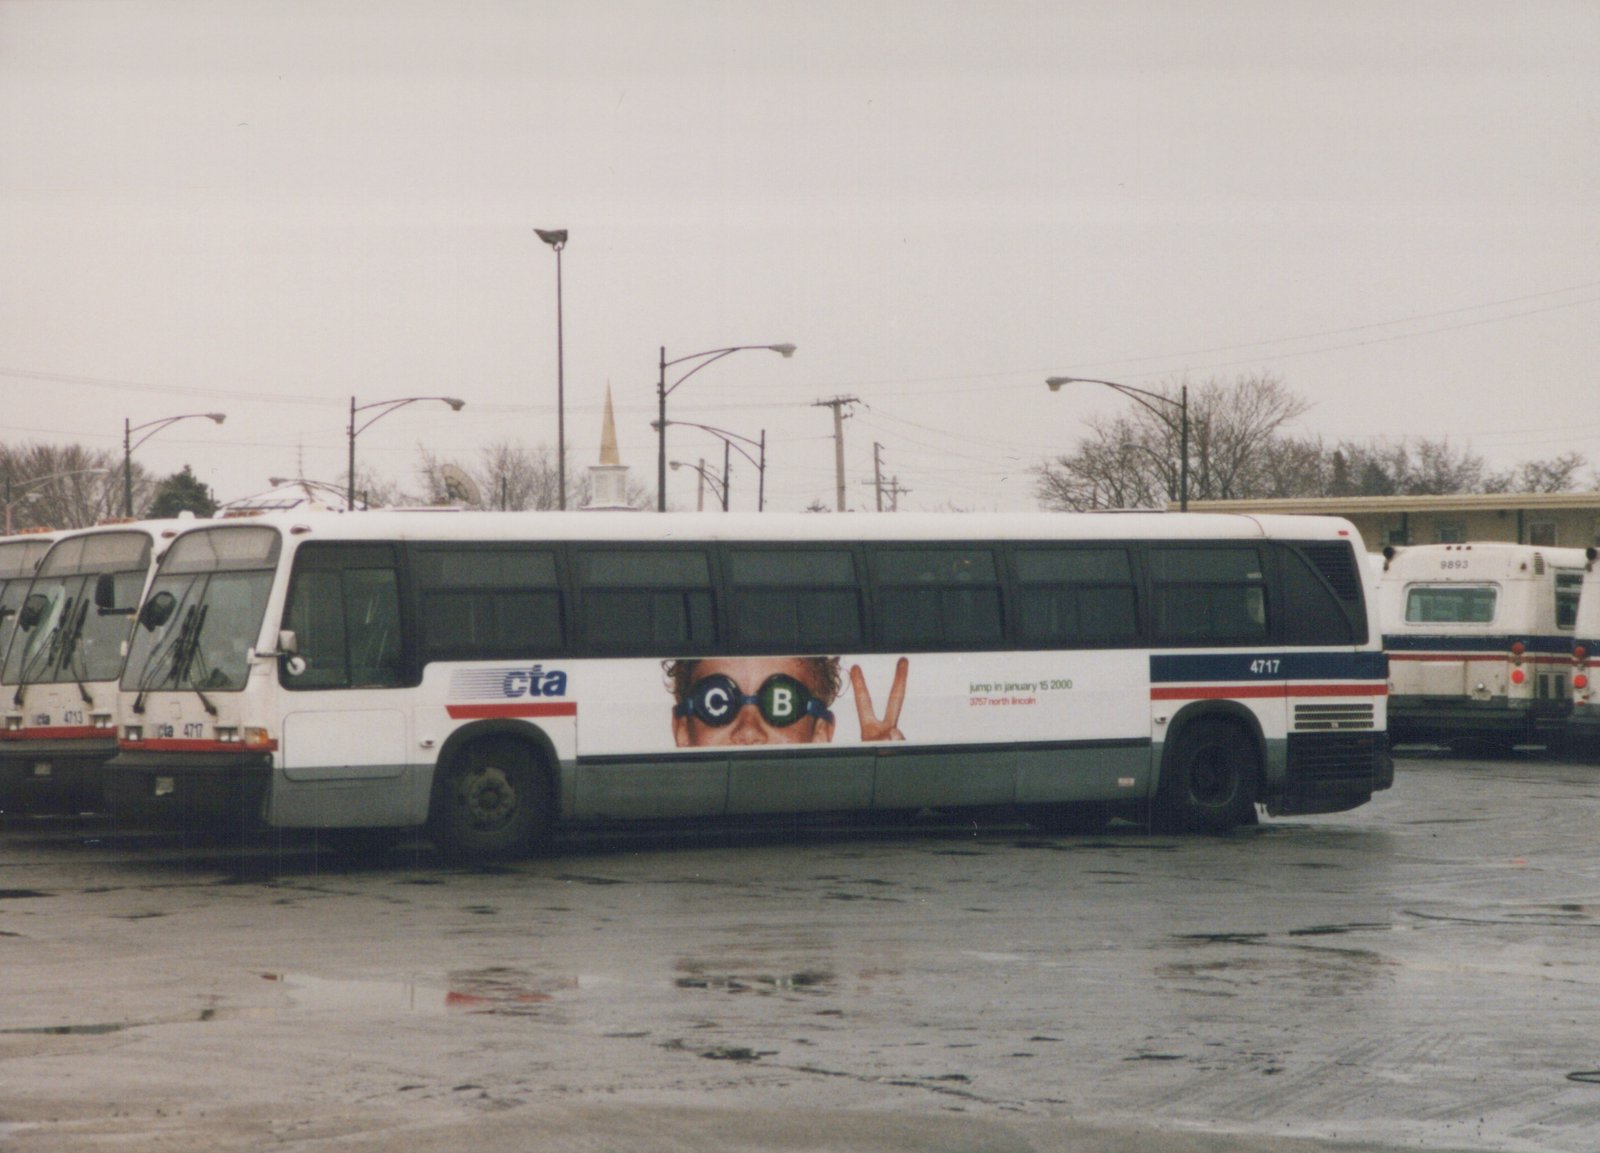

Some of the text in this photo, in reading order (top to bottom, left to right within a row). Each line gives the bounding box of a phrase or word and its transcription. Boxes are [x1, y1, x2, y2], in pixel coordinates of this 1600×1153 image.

[1440, 560, 1468, 570] 9893
[1250, 660, 1280, 673] 4717
[503, 665, 567, 697] cta
[970, 679, 1072, 694] jump in january 15 2000
[705, 688, 792, 716] C B
[969, 697, 1036, 706] 3757 north lincoln
[64, 711, 83, 724] 4713
[184, 723, 203, 737] 4717
